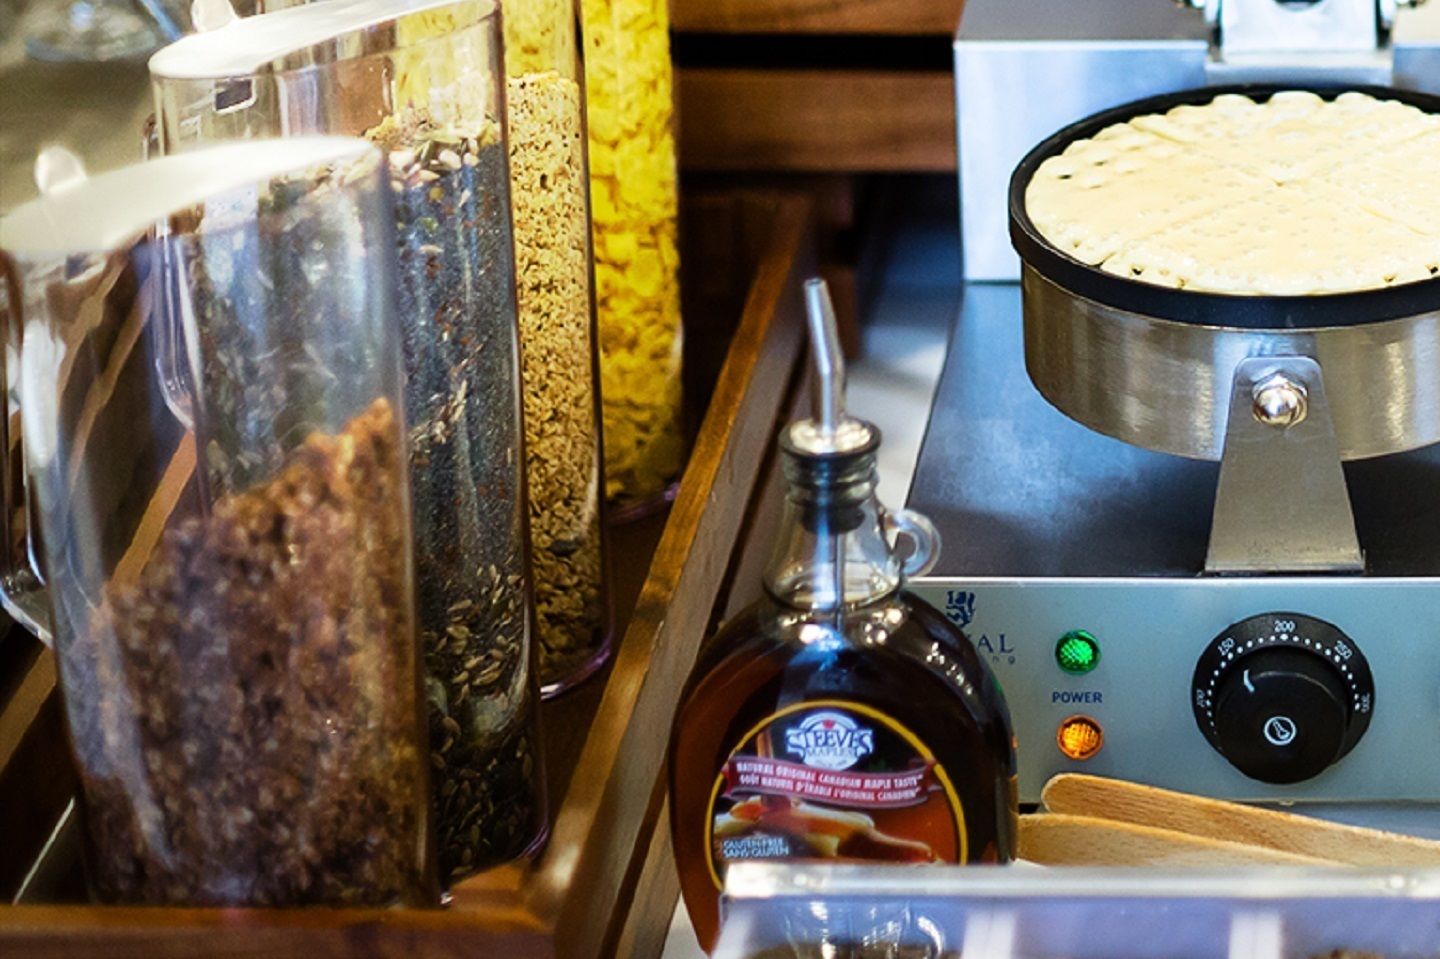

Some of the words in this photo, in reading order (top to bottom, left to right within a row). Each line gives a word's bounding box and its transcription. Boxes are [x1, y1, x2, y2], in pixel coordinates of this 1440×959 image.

[1274, 620, 1296, 633] 200
[1217, 637, 1235, 657] 150
[1333, 640, 1353, 660] 250
[1052, 691, 1103, 704] POWER
